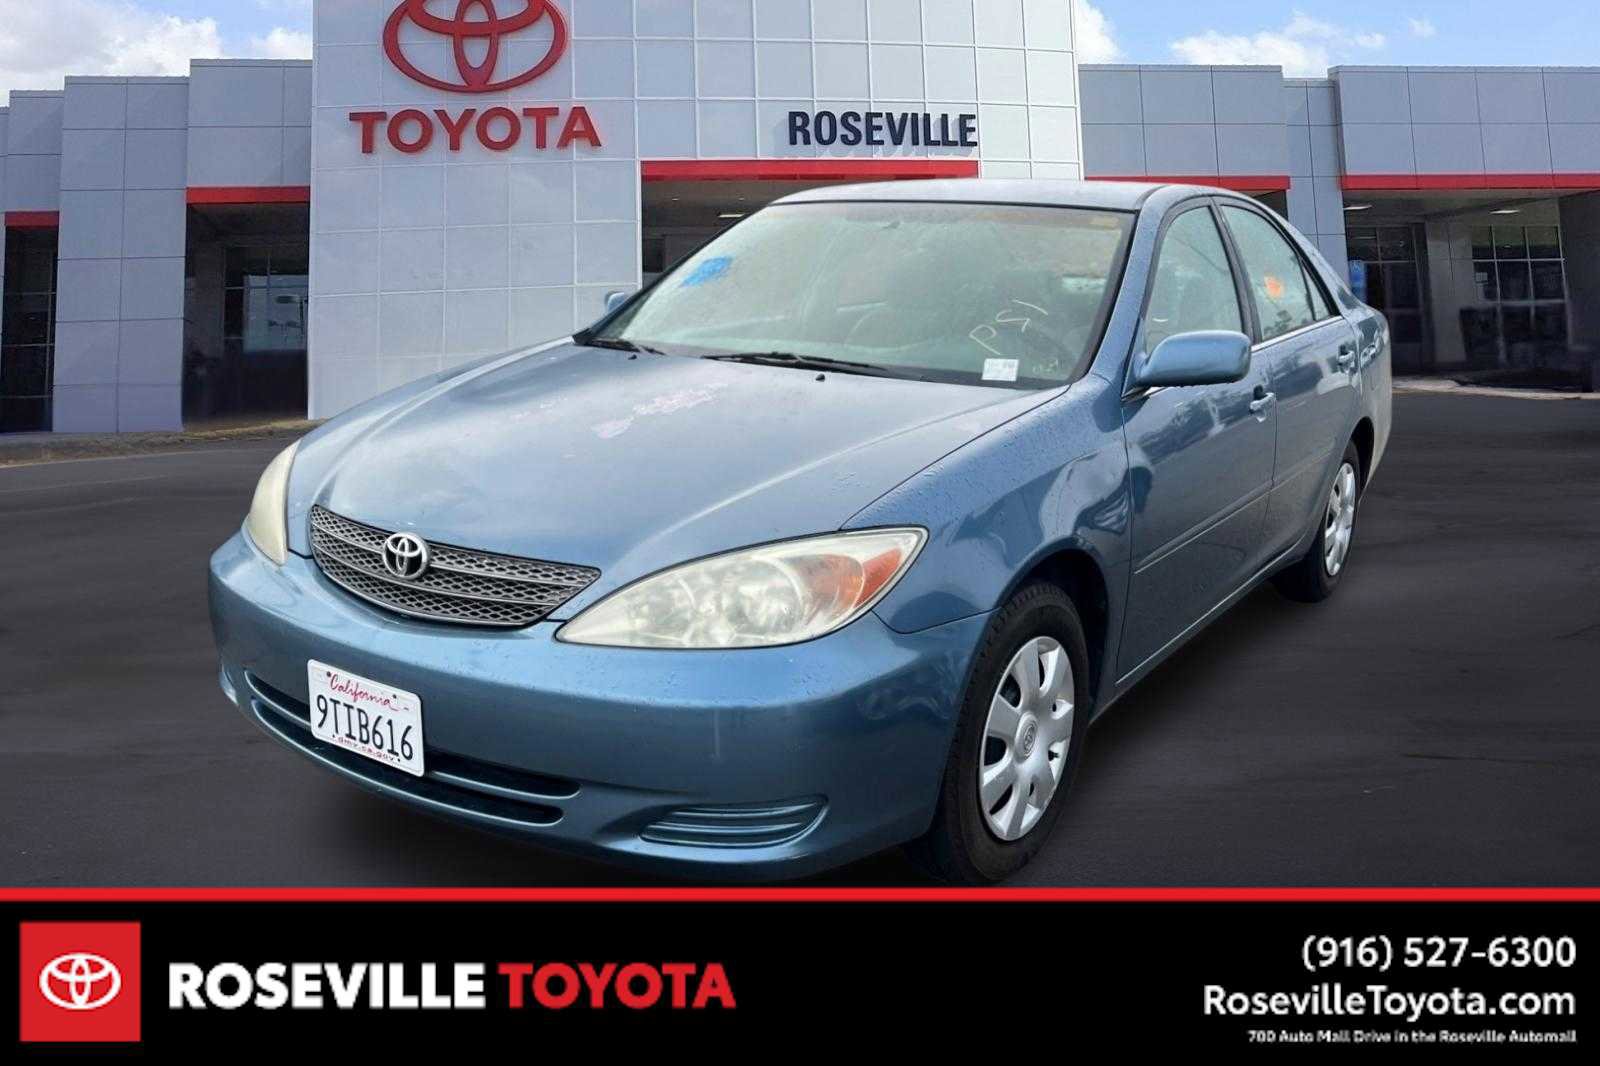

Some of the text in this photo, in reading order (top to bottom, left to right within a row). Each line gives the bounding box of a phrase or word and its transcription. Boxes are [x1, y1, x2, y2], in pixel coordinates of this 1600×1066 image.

[349, 106, 603, 154] TOYOTA
[788, 111, 978, 147] ROSEVILLE
[330, 673, 398, 711] California
[316, 694, 414, 761] 9TIB616
